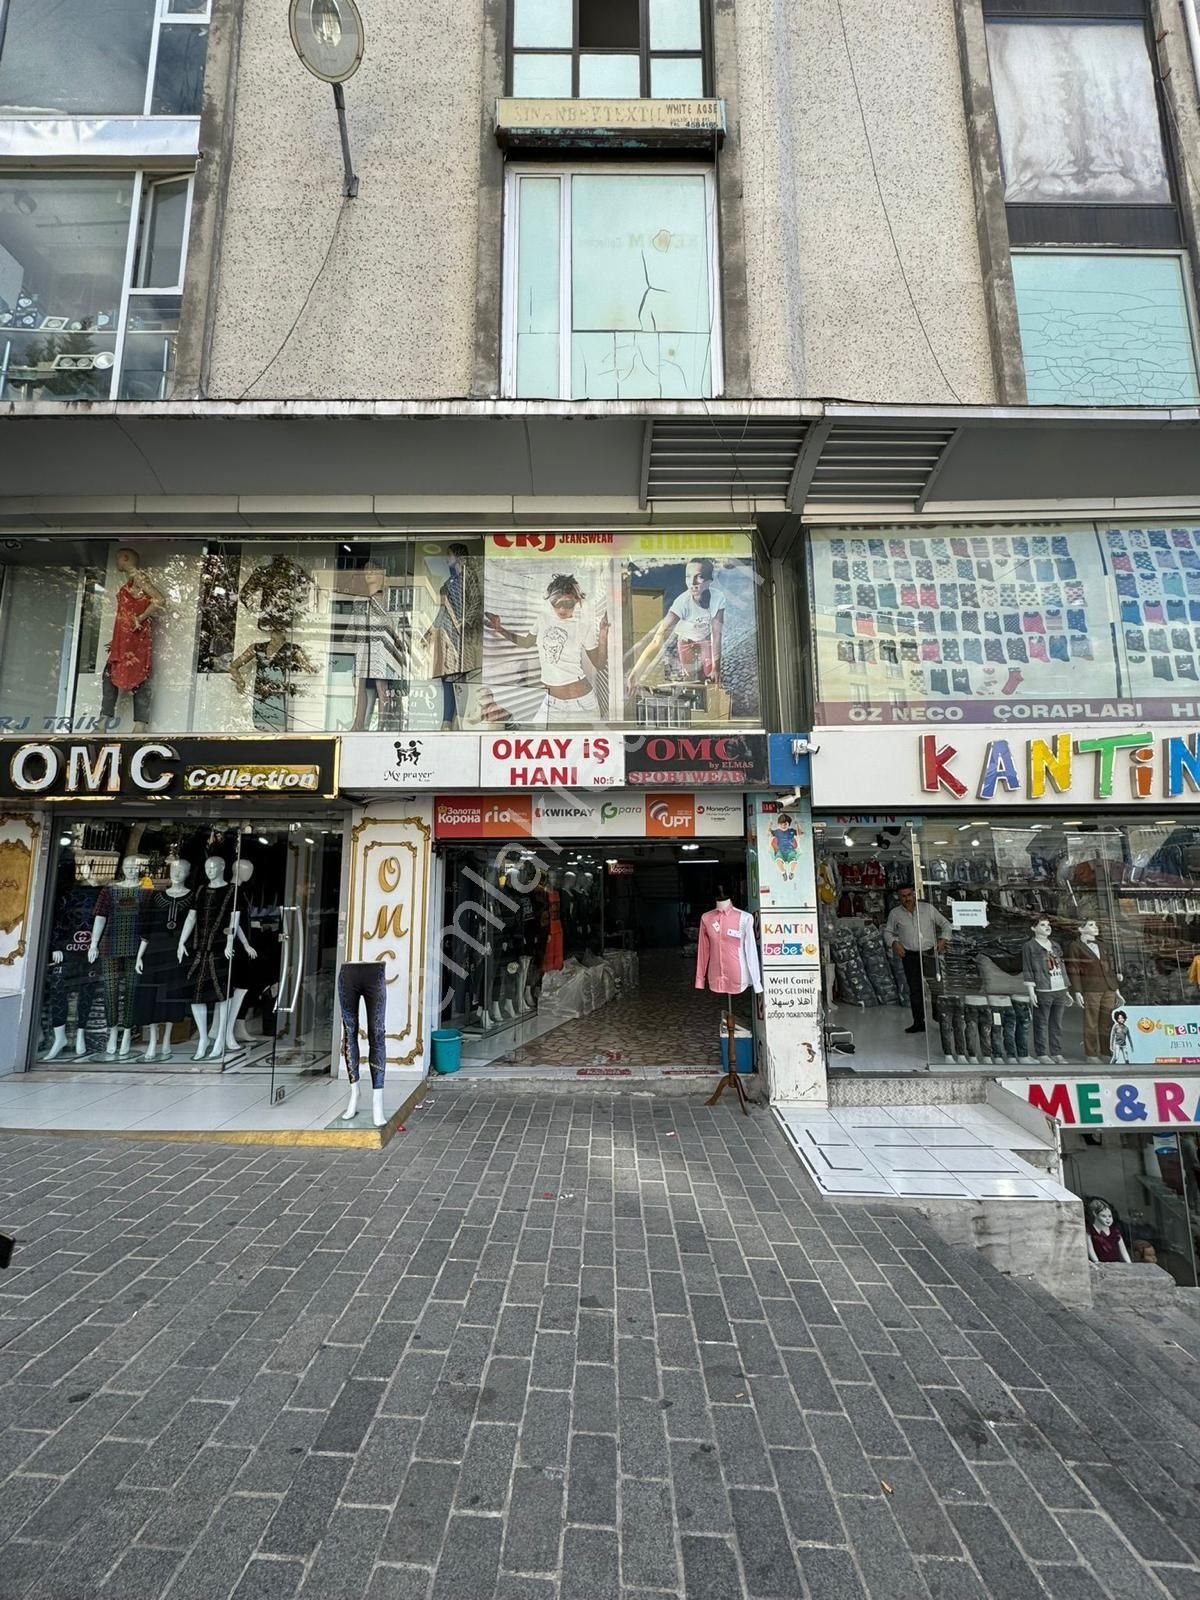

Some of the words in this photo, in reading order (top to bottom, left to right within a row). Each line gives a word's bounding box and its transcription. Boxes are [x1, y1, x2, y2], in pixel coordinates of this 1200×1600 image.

[666, 104, 692, 114] WHITE
[560, 534, 614, 544] JEANSWEAR
[848, 703, 883, 722] ÖZ
[892, 706, 964, 721] NECO
[992, 703, 1143, 723] ÇORAPLARI
[492, 738, 573, 760] OKAY
[646, 738, 742, 761] OMC
[11, 743, 177, 791] OMC
[188, 768, 317, 788] Collection
[709, 761, 719, 769] by
[722, 761, 754, 769] ELMAS
[383, 770, 400, 782] My
[402, 772, 433, 782] prayer
[510, 767, 578, 786] HANI
[593, 776, 615, 785] NO:5
[628, 771, 745, 784] SPORTWEAR
[447, 806, 481, 815] Золотая
[485, 805, 511, 823] ria
[542, 808, 595, 817] KWIKPAY
[438, 814, 481, 825] Корона
[661, 813, 693, 828] UPT
[765, 941, 800, 956] bebe
[769, 976, 789, 985] Well
[790, 976, 815, 985] Come
